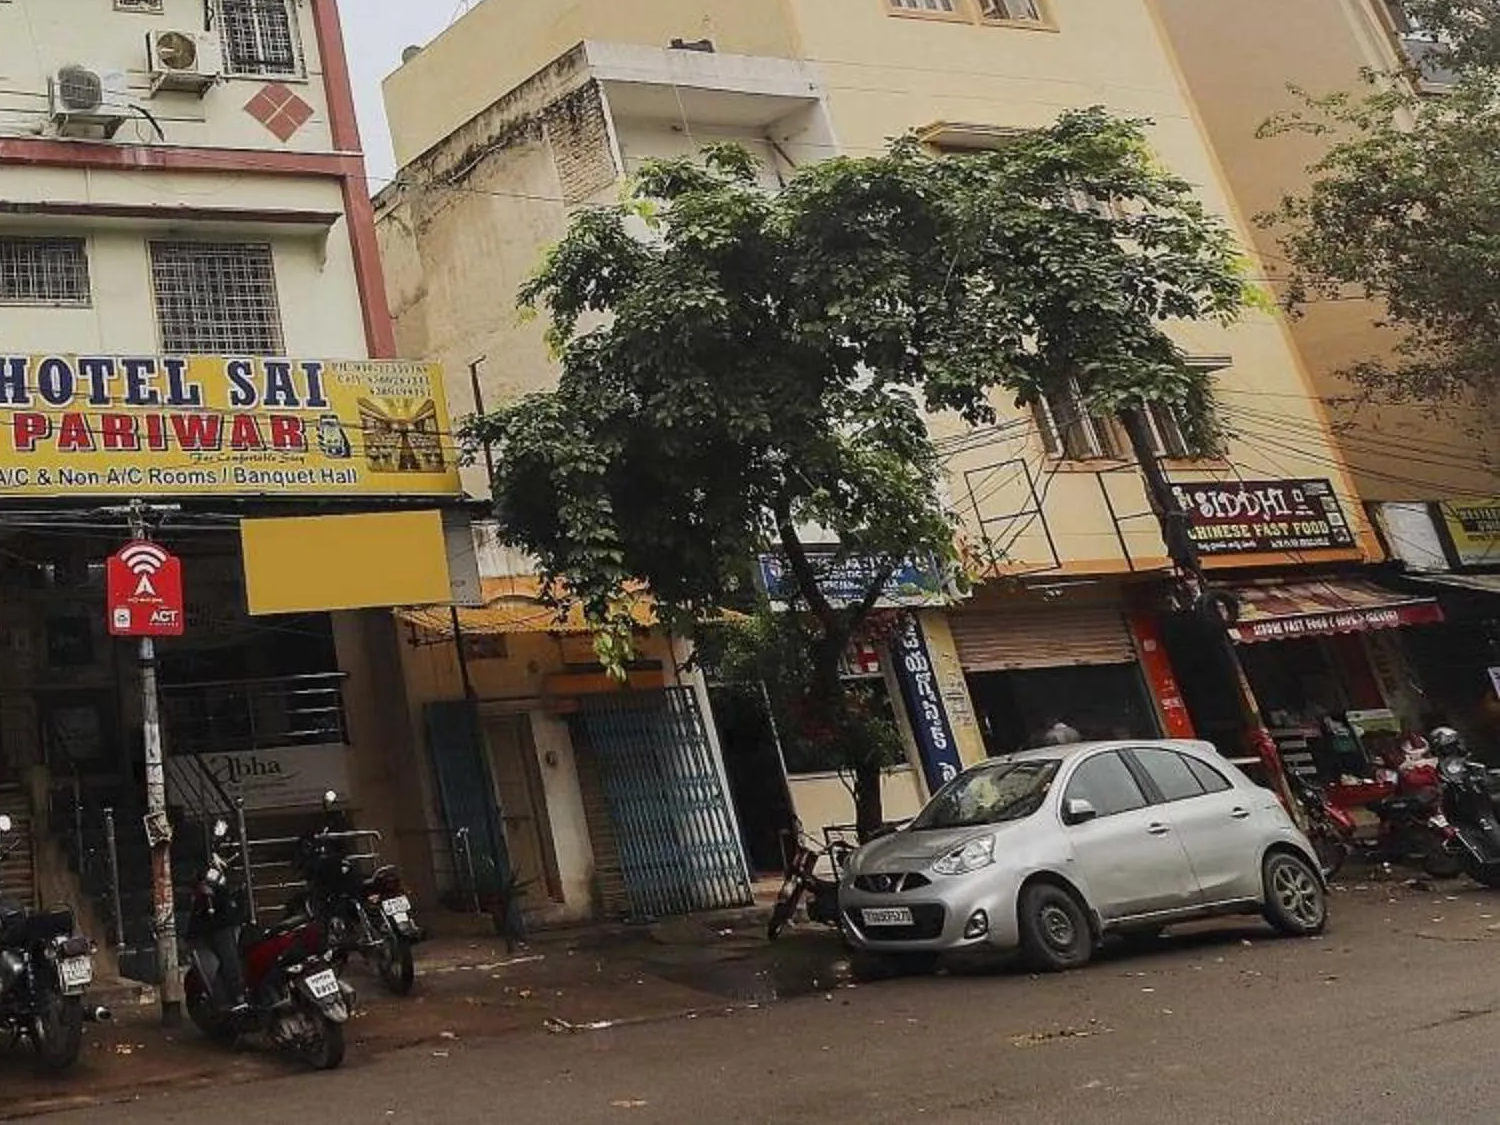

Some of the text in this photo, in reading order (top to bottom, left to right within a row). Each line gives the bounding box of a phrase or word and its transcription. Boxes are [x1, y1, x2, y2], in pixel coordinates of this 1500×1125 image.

[227, 359, 329, 408] SAI
[13, 411, 308, 452] PARIWAR
[37, 468, 51, 486] &
[59, 469, 100, 485] Non
[107, 468, 141, 486] A/C
[150, 468, 217, 485] Rooms
[235, 469, 317, 488] Banquet
[322, 469, 358, 484] Hall
[1194, 488, 1293, 521] SIDDHI
[1187, 520, 1330, 541] CHINESE FAST FOOD
[150, 610, 179, 623] ACT
